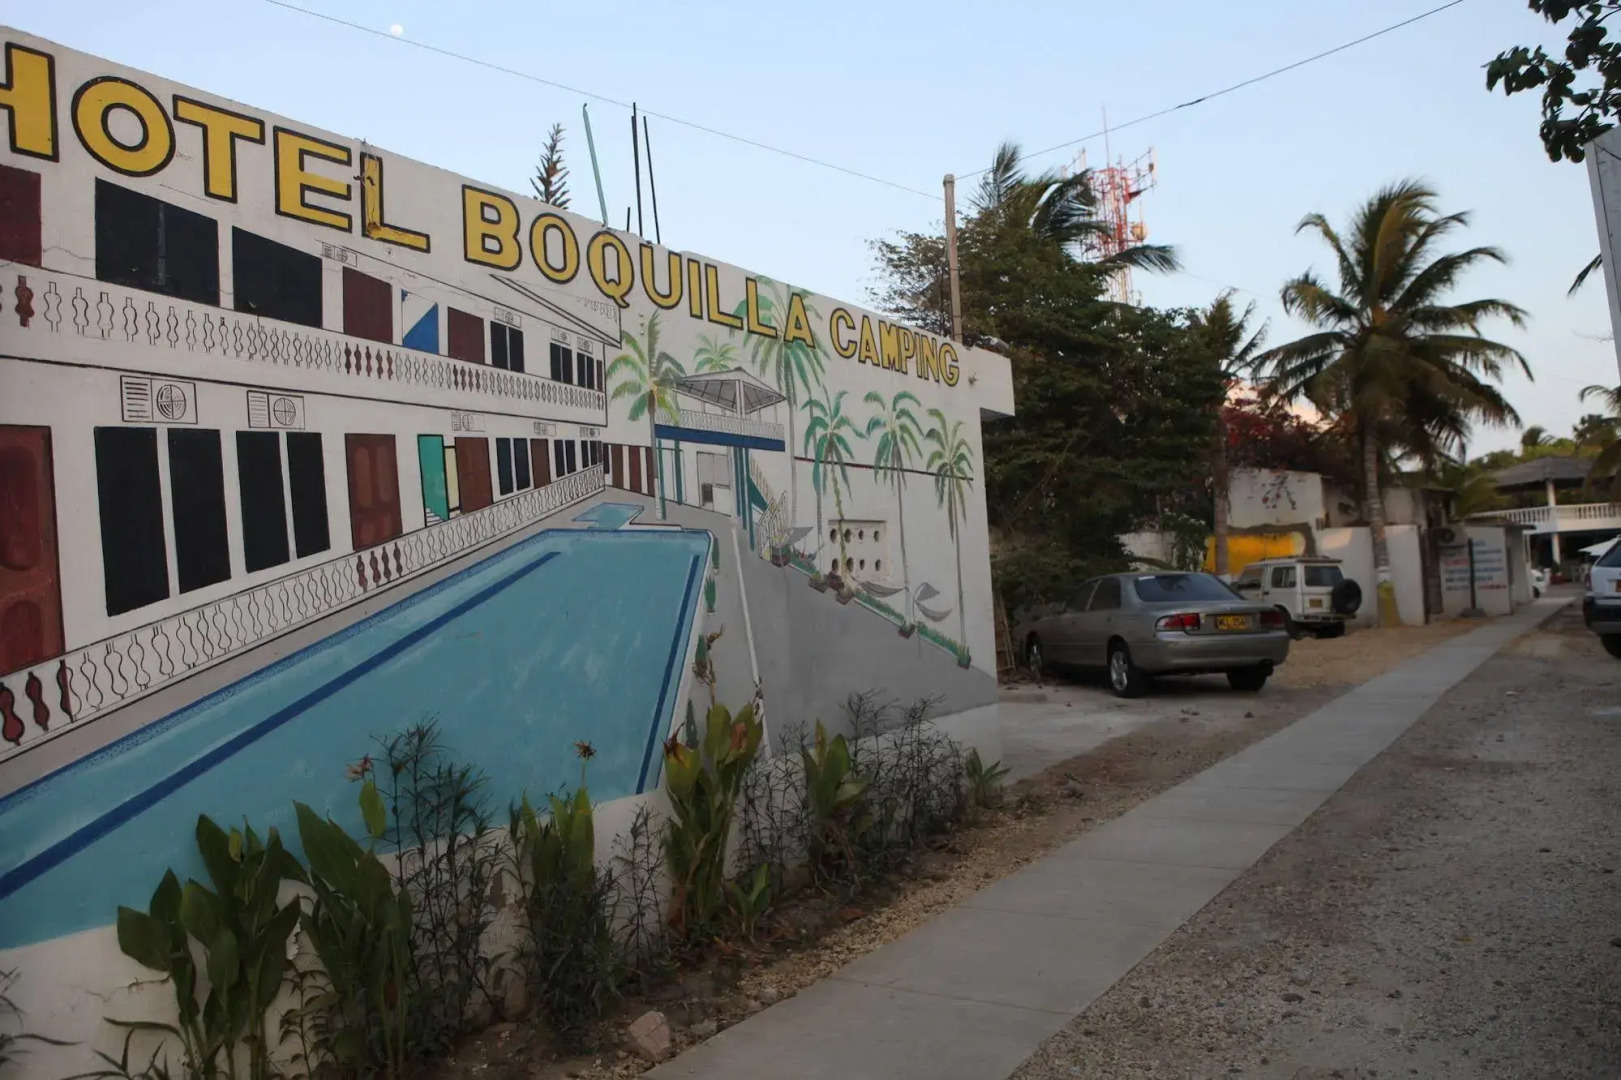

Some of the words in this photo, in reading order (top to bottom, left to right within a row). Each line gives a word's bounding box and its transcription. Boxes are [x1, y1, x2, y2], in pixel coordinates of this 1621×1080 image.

[0, 41, 430, 254] HOTEL
[462, 184, 816, 349] BOQUILLA
[829, 307, 960, 387] CAMPING
